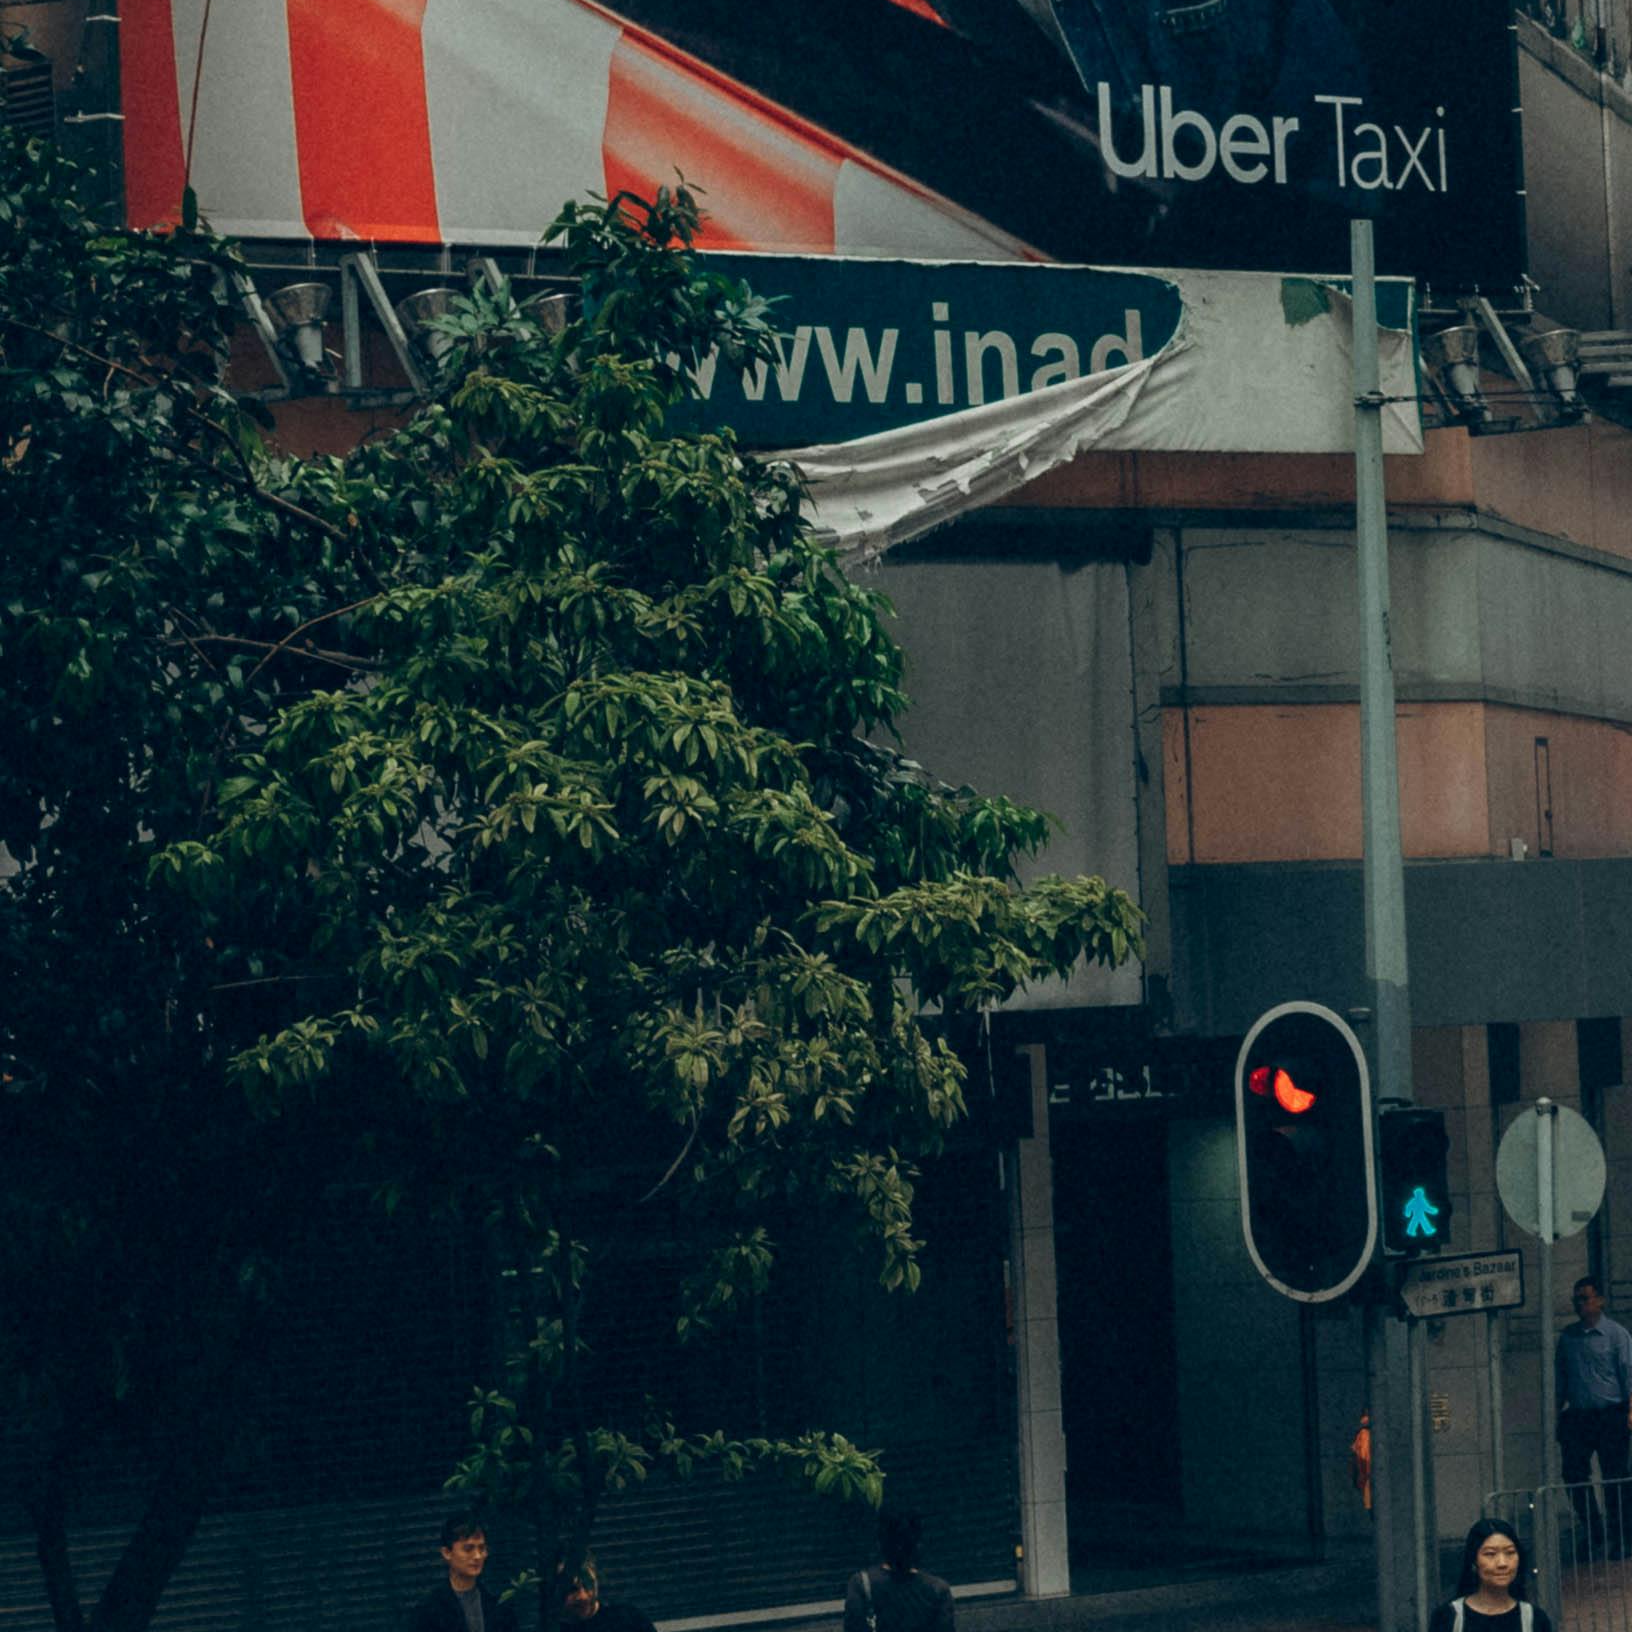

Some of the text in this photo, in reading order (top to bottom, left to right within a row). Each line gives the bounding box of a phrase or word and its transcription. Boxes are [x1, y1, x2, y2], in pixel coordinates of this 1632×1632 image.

[1097, 82, 1448, 193] Uber Taxi
[1420, 1260, 1516, 1282] Jardine's Bazaar
